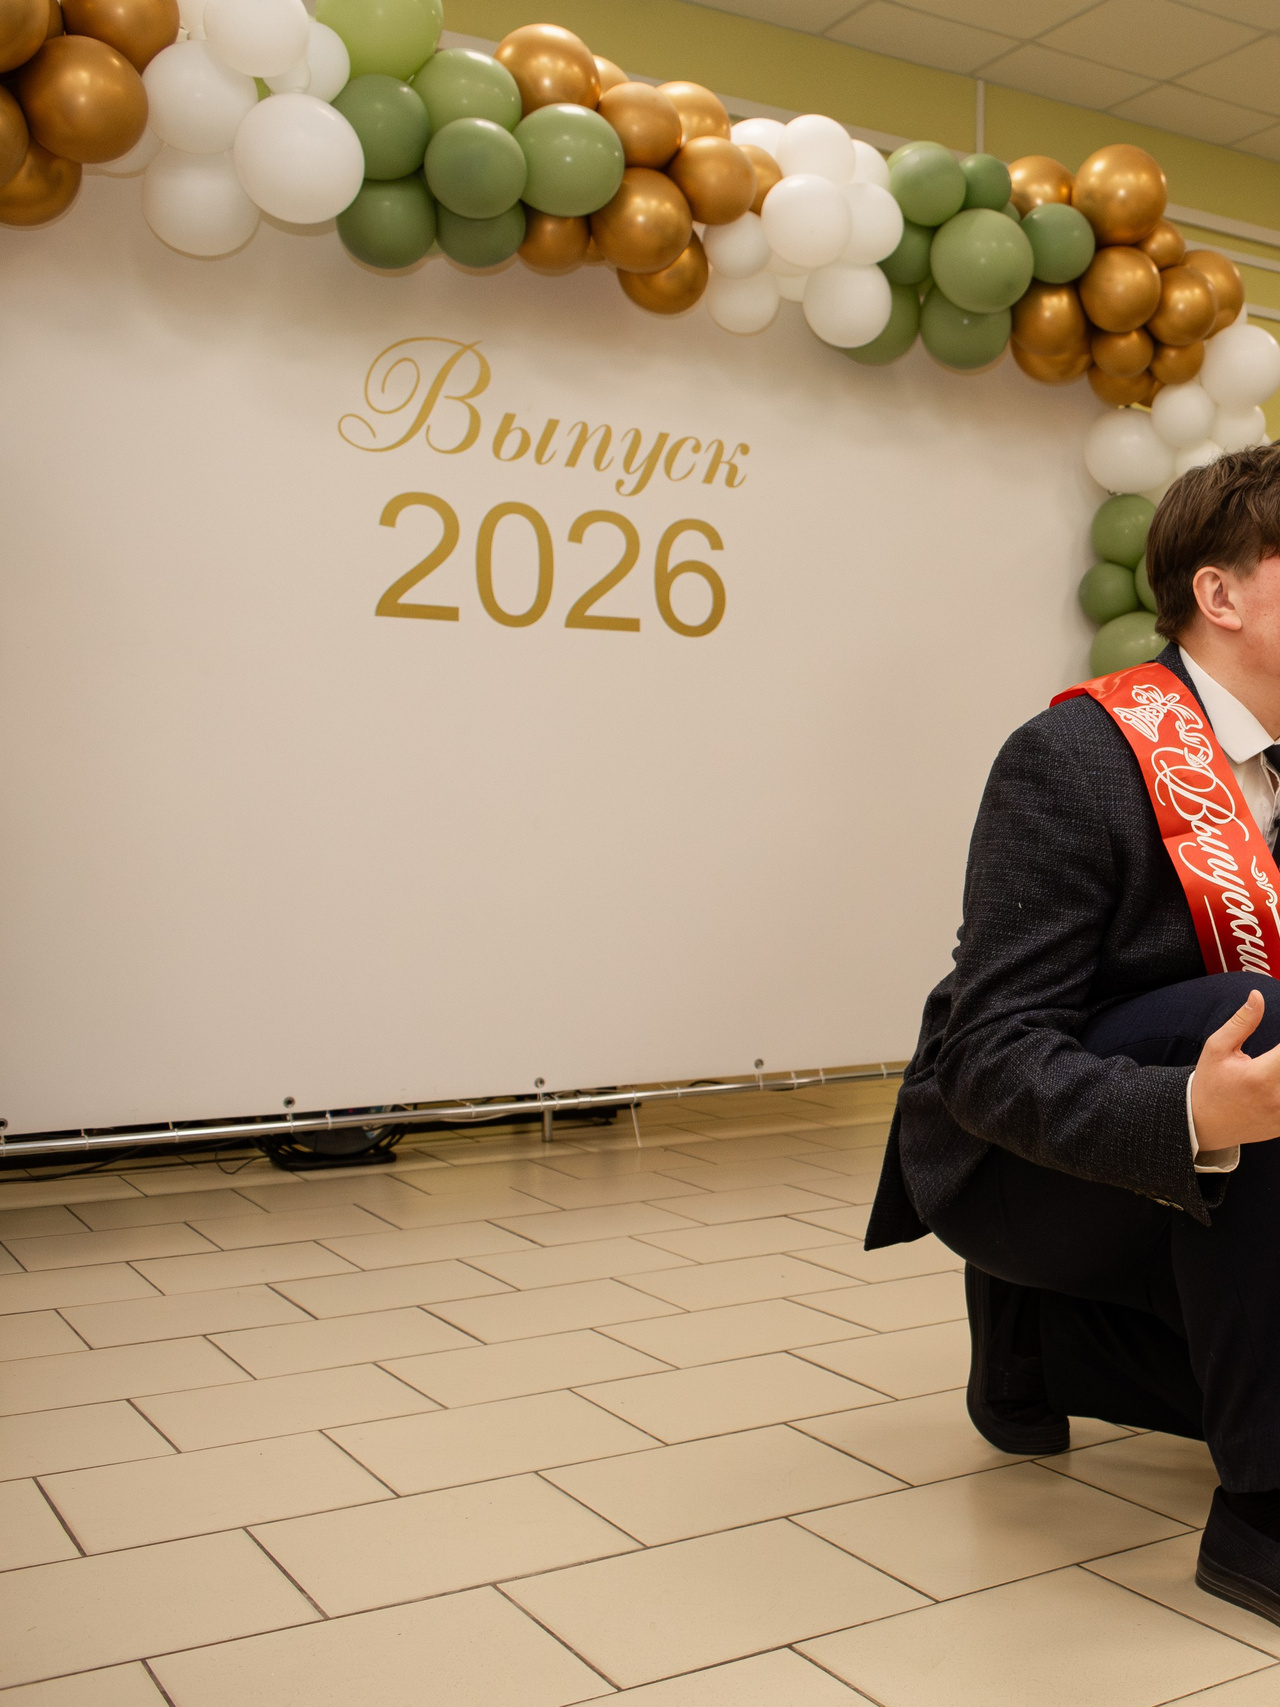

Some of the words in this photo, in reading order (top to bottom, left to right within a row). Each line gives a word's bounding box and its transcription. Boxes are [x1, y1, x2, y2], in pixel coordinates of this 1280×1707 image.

[338, 336, 750, 496] Выпуск
[375, 491, 726, 637] 2026
[1151, 747, 1273, 977] Выпускни
